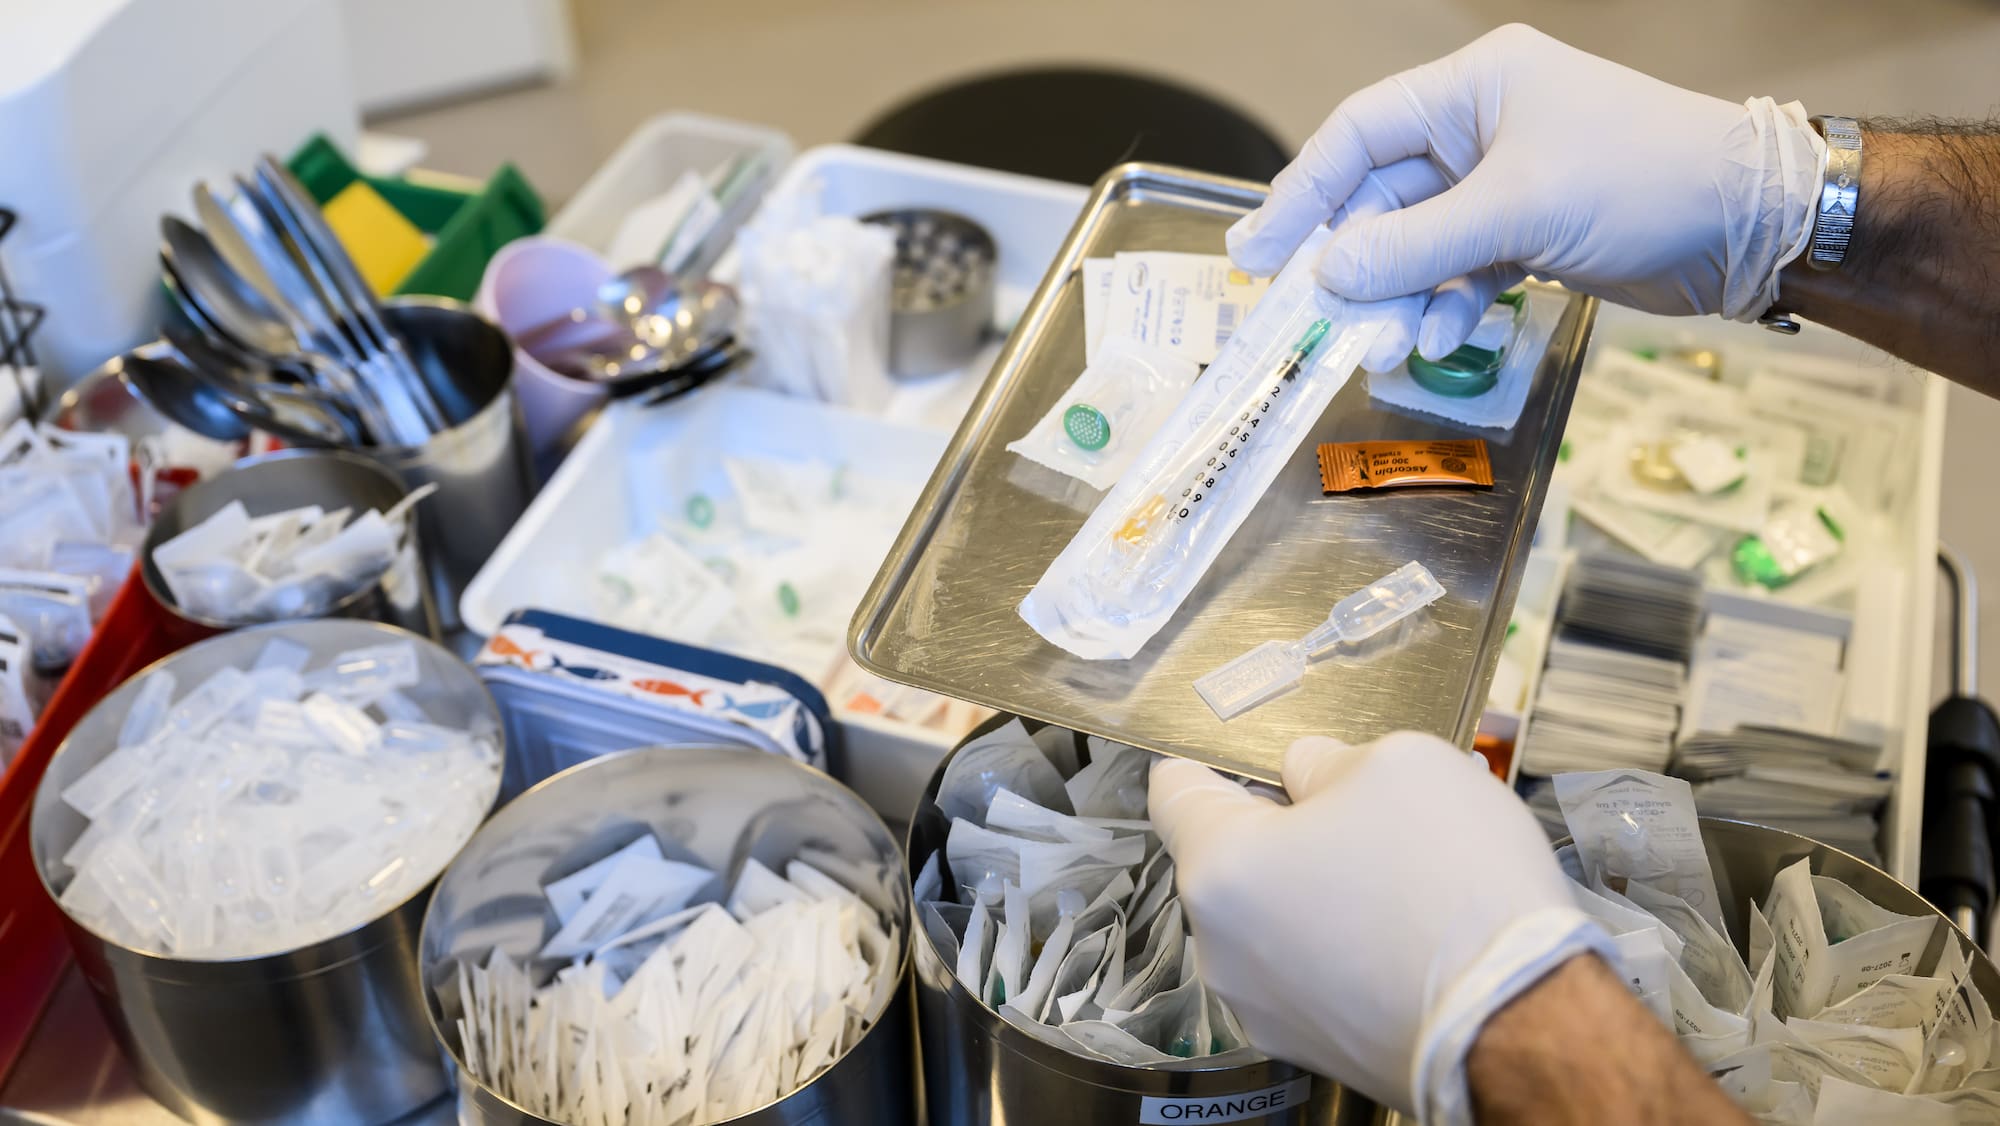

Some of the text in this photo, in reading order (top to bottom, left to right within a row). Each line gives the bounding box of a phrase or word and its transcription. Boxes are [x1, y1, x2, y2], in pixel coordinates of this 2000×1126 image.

[1240, 412, 1260, 428] 0.4
[1230, 426, 1250, 442] 0.5
[1219, 441, 1238, 458] 0.6
[1207, 457, 1227, 472] 0.7
[1373, 459, 1389, 467] mg
[1375, 465, 1428, 476] Ascorbin
[1195, 472, 1215, 488] 0.8
[1182, 488, 1202, 503] 0.9
[1169, 503, 1189, 519] 1.0
[1160, 1091, 1286, 1119] ORANGE
